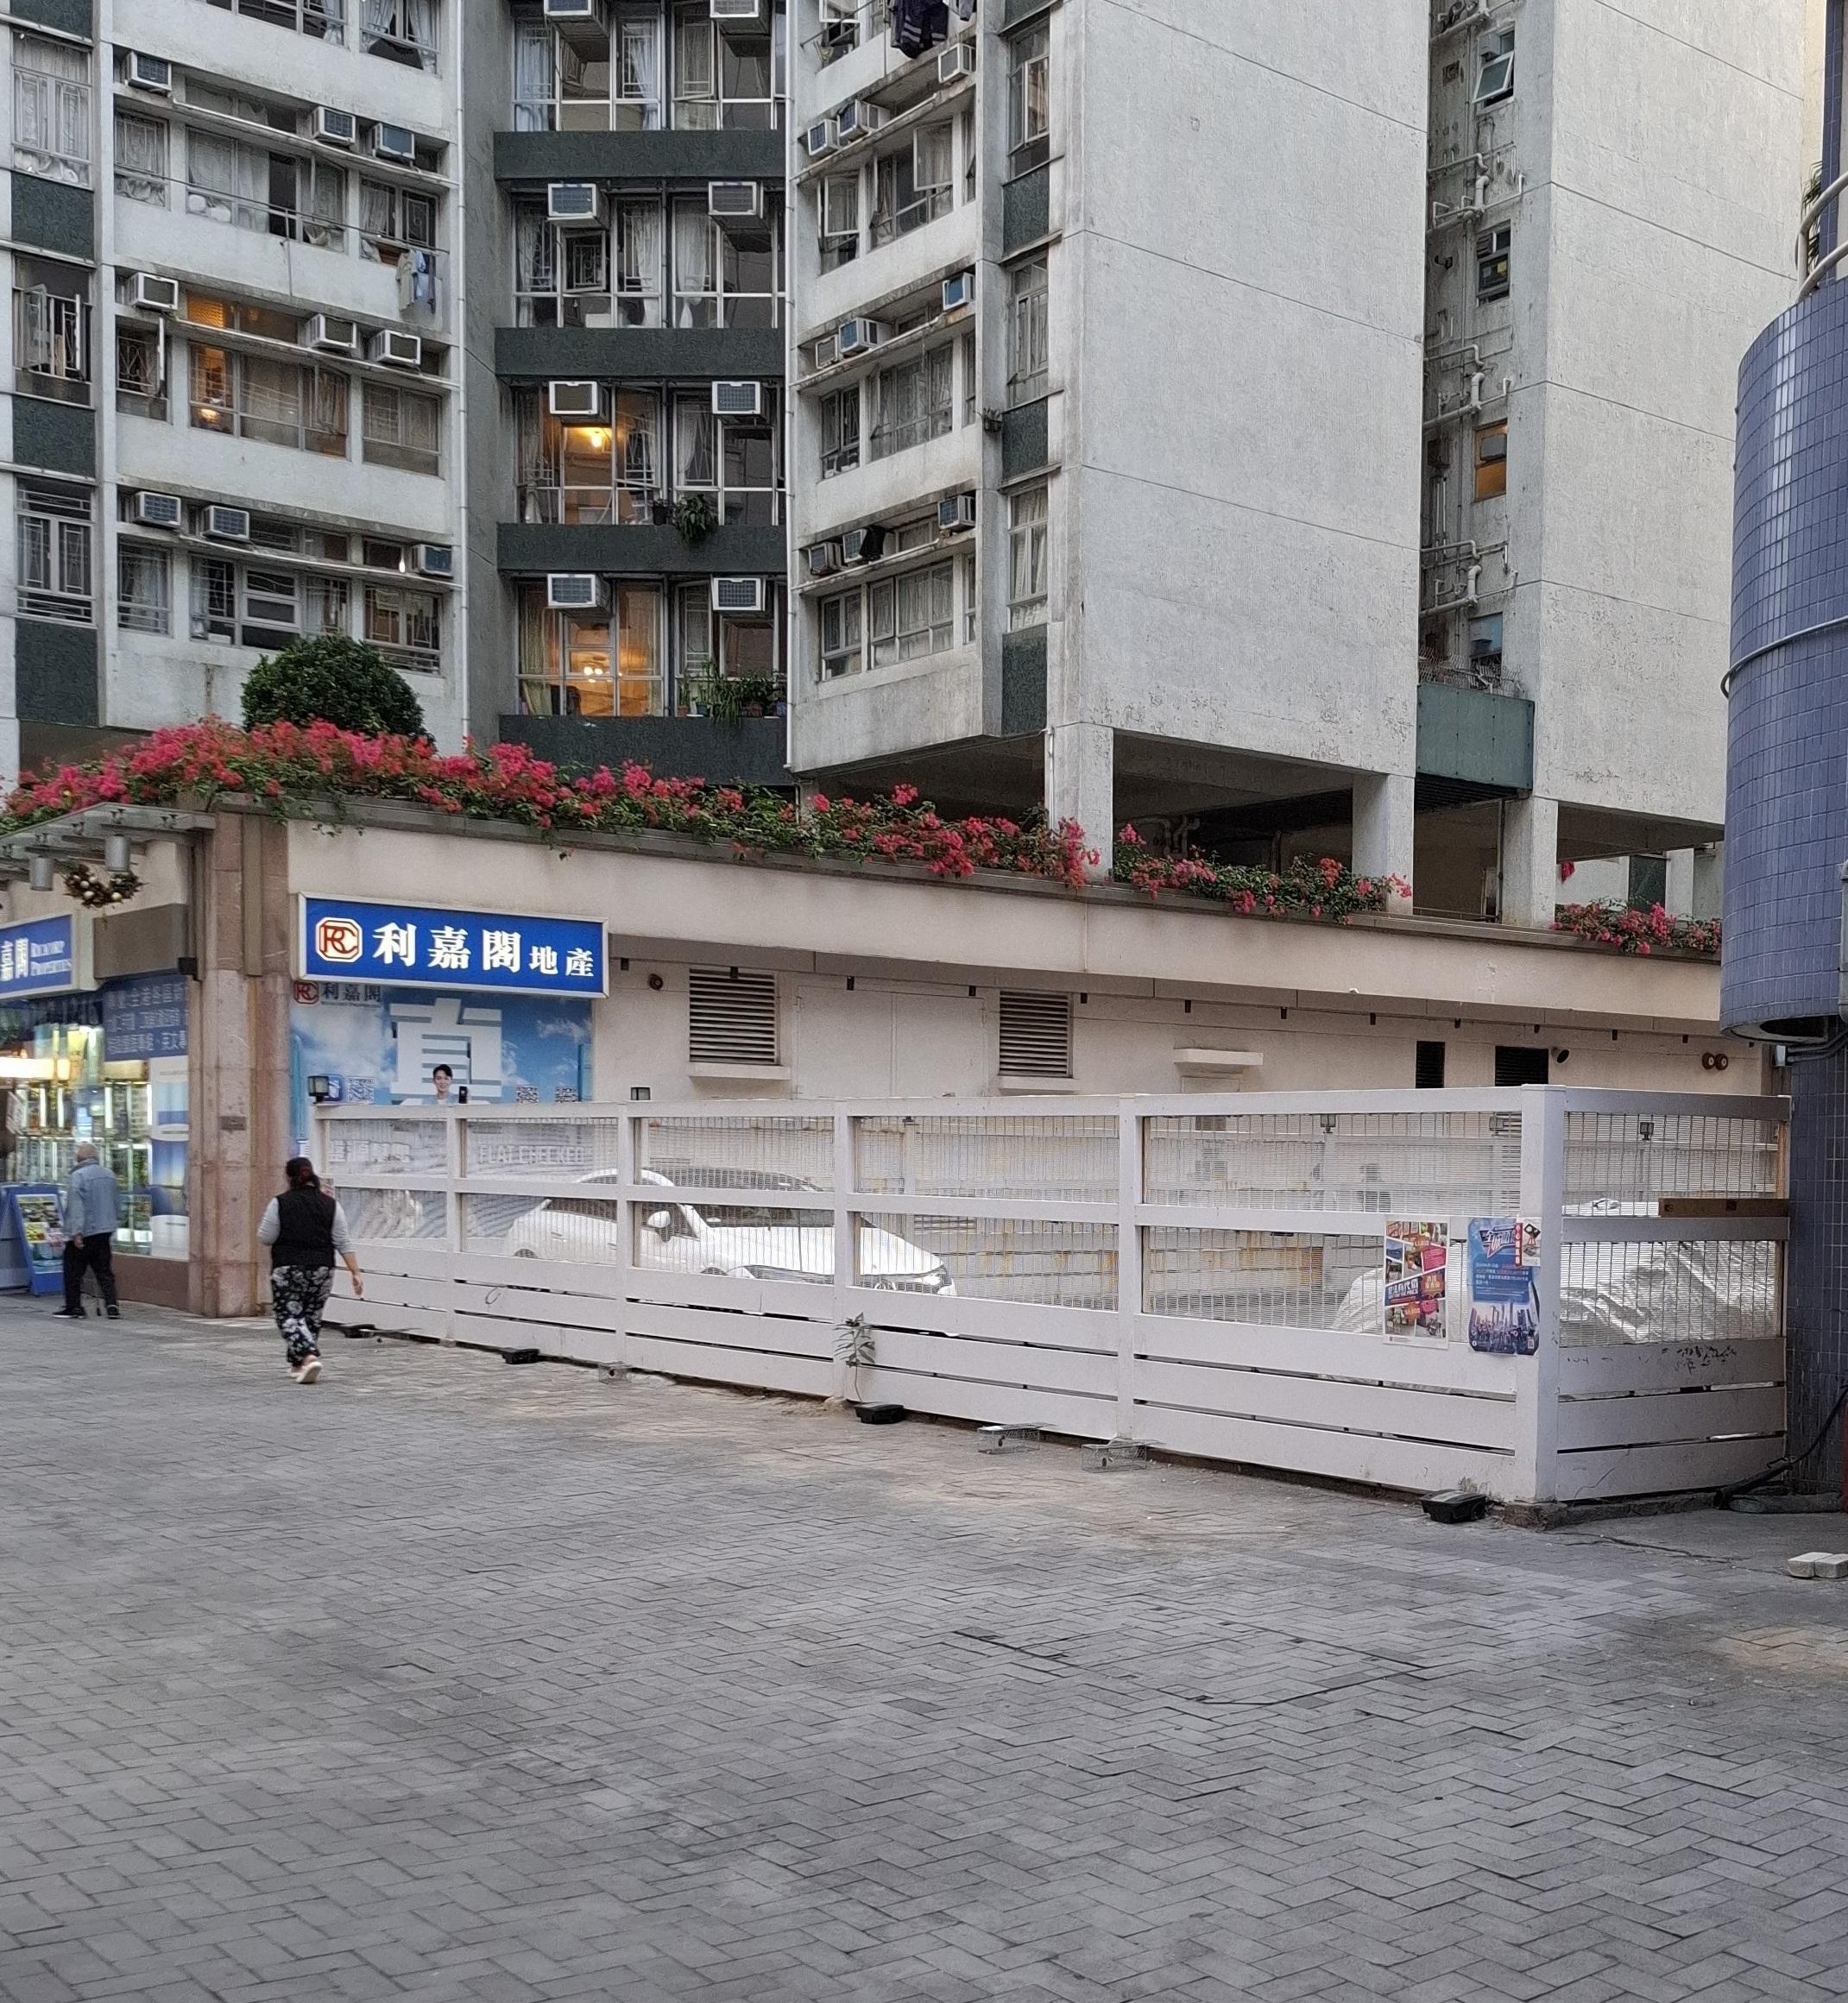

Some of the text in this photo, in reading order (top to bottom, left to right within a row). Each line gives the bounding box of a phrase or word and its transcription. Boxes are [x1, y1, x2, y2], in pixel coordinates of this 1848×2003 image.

[373, 922, 595, 977] 利嘉閣地產
